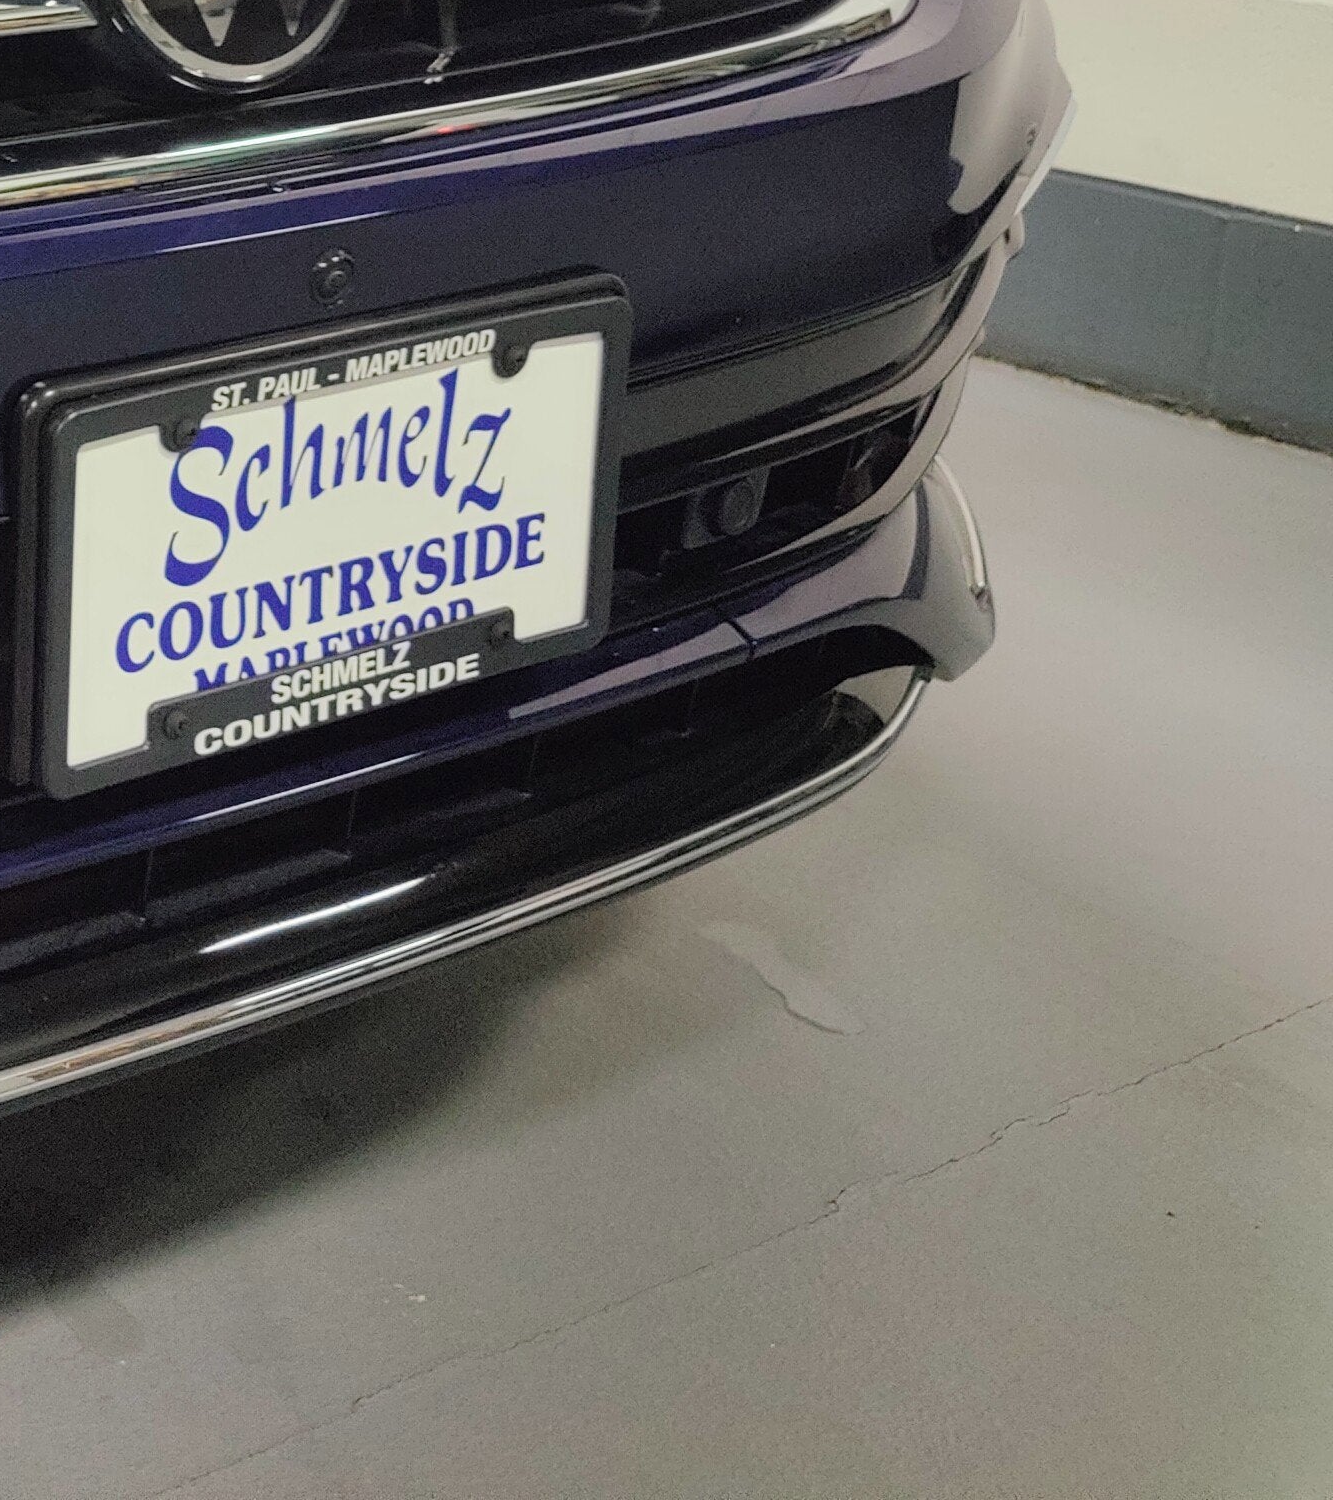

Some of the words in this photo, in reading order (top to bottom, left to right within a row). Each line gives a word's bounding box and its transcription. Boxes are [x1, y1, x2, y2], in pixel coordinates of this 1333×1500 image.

[210, 380, 251, 412] ST.
[256, 366, 322, 402] PAUL
[343, 328, 497, 383] MAPLEWOOD
[163, 368, 511, 587] Schmelz
[114, 512, 546, 674] COUNTRYSIDE
[193, 652, 481, 757] COUNTRYSIDE
[270, 640, 411, 705] SCHMELZ
